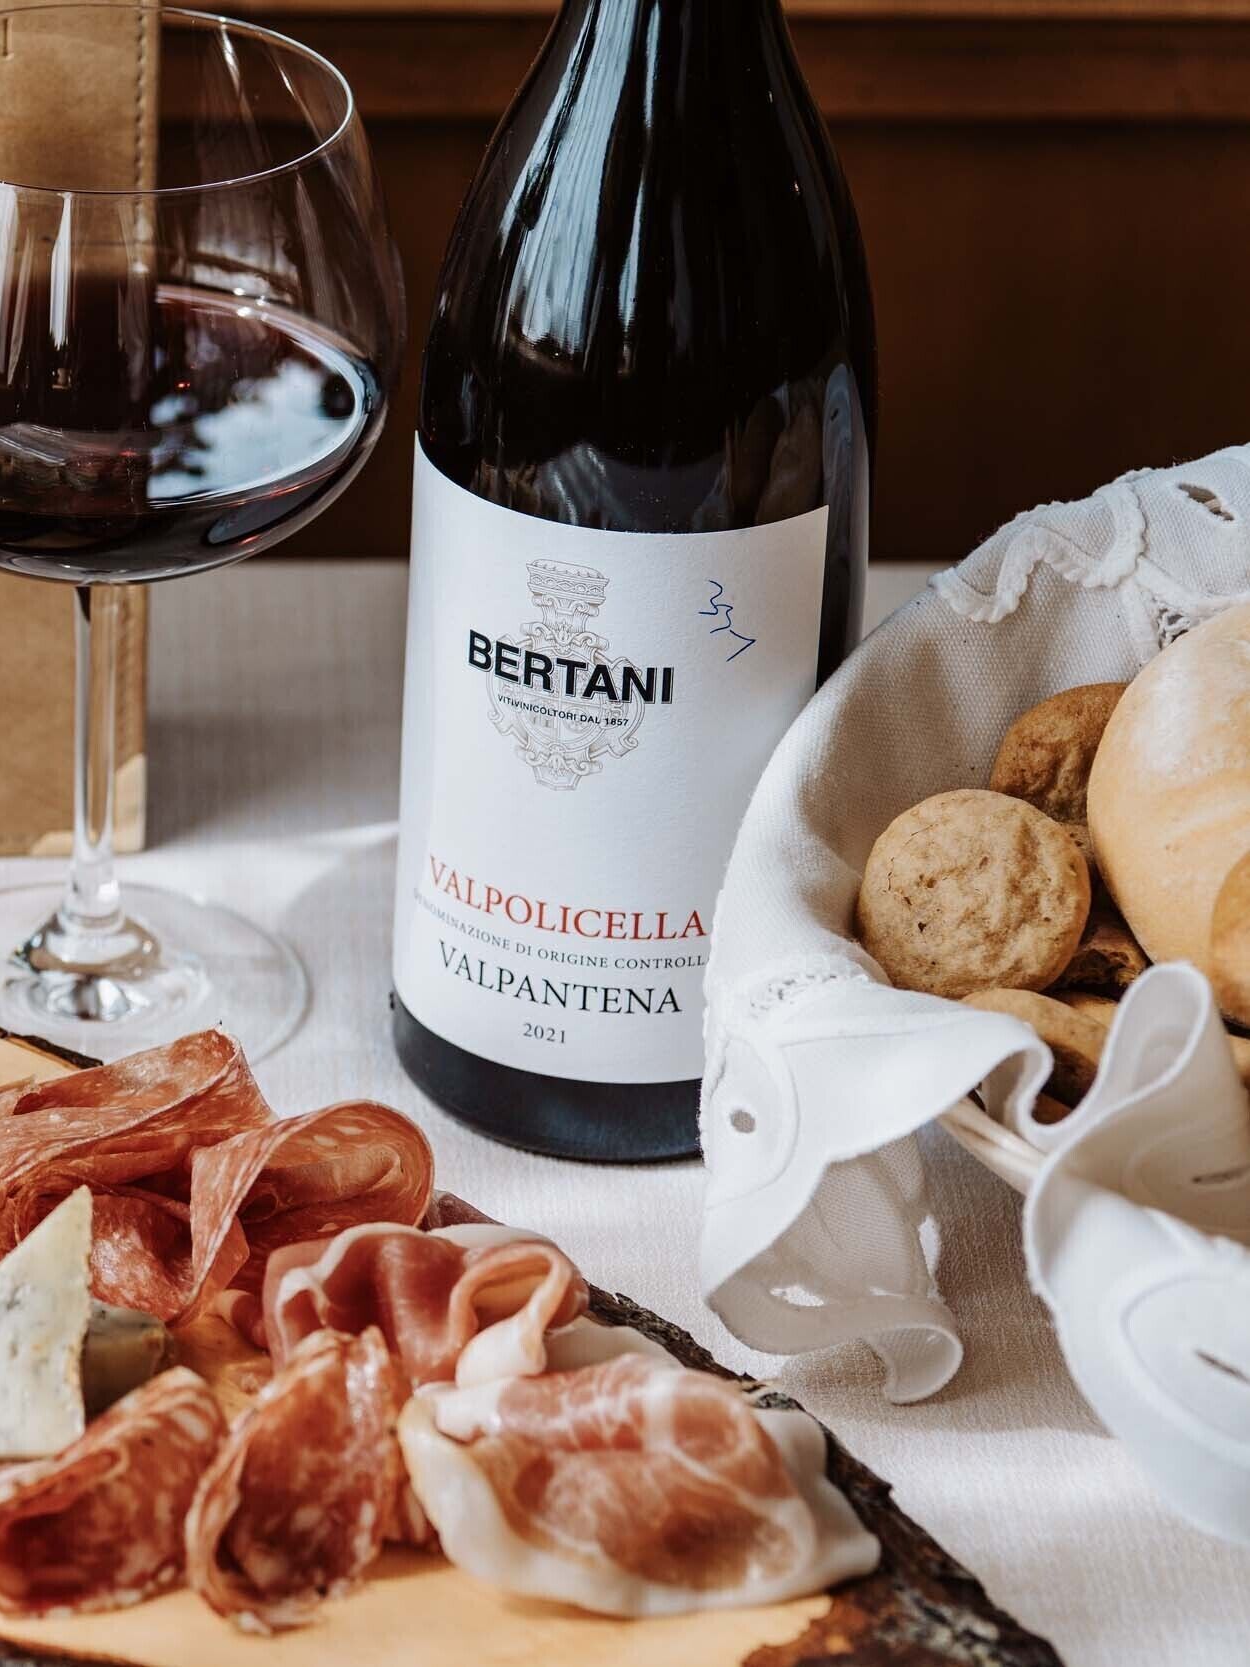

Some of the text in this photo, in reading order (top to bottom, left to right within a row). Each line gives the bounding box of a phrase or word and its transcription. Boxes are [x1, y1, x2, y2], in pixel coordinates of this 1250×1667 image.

[468, 629, 675, 705] BERTANI
[497, 694, 630, 727] VITIVINICOLTORI DAL 1857
[430, 855, 708, 941] VALPOLICELLA
[438, 938, 683, 1015] VALPANTENA
[515, 942, 533, 957] DI
[537, 948, 610, 969] ORIGINE
[614, 954, 710, 969] CONTROLL
[522, 1022, 567, 1045] 2021
